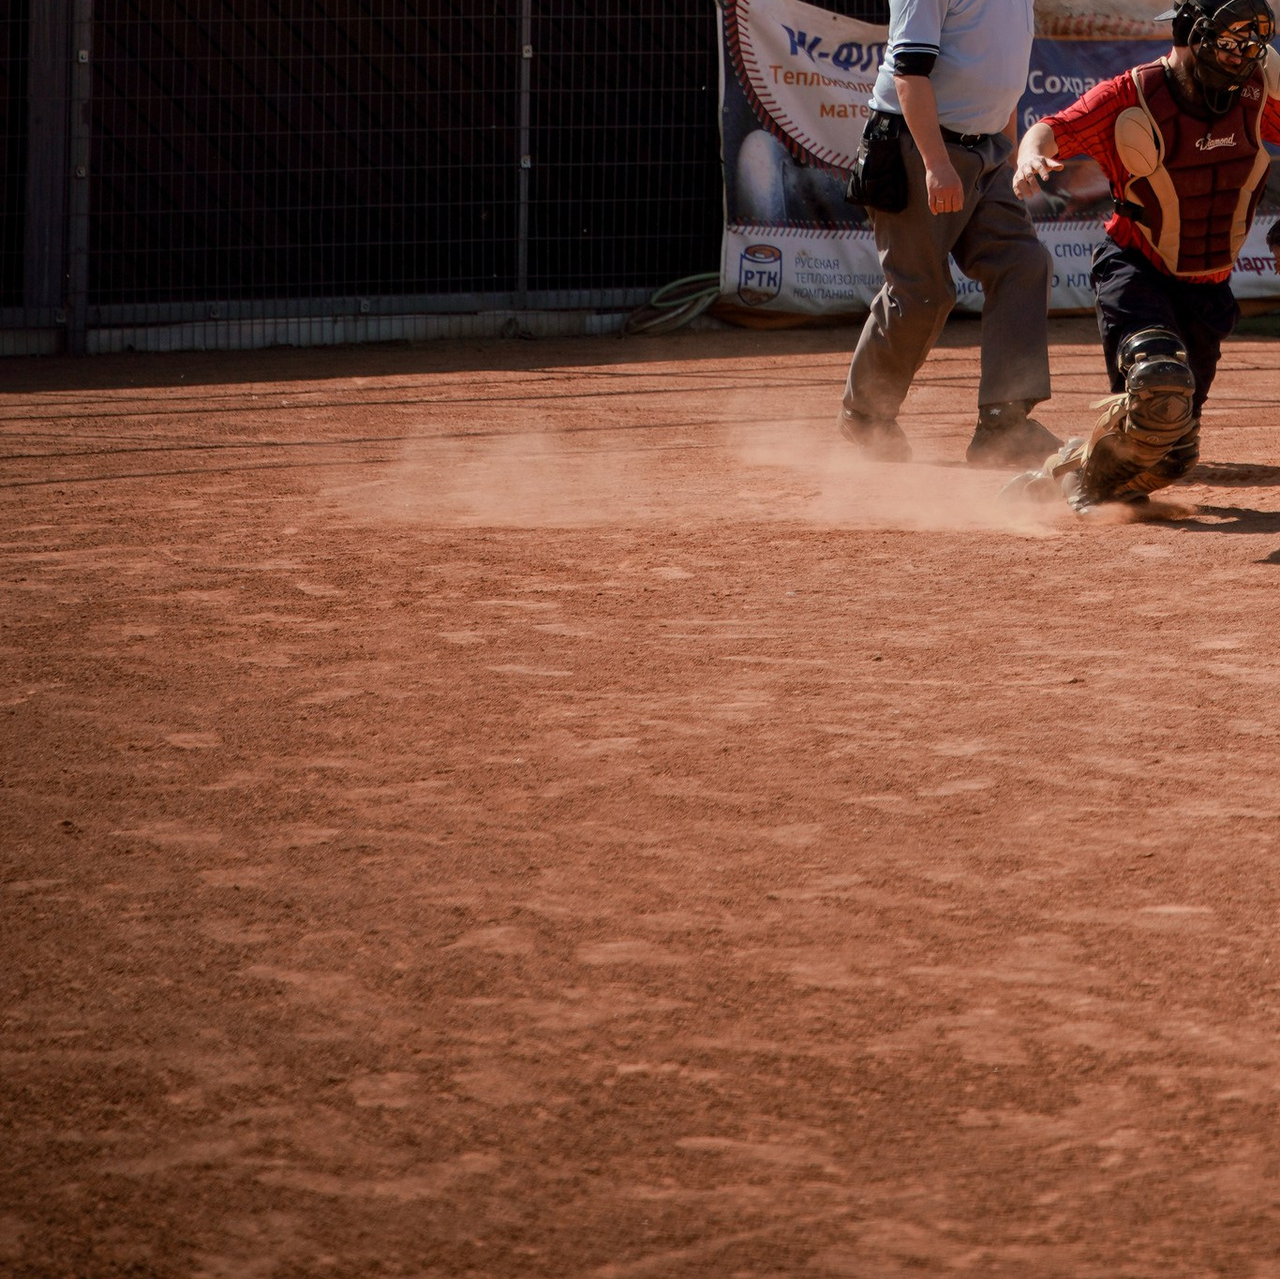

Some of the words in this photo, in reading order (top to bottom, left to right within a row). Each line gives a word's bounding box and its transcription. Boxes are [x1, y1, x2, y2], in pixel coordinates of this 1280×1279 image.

[1028, 70, 1112, 98] Сохра
[1195, 133, 1236, 151] Diamond
[1054, 242, 1103, 258] спон
[795, 257, 840, 270] РУССКАЯ
[1232, 256, 1276, 276] парт
[743, 271, 778, 287] РТК
[794, 287, 854, 299] КОМПАНИЯ
